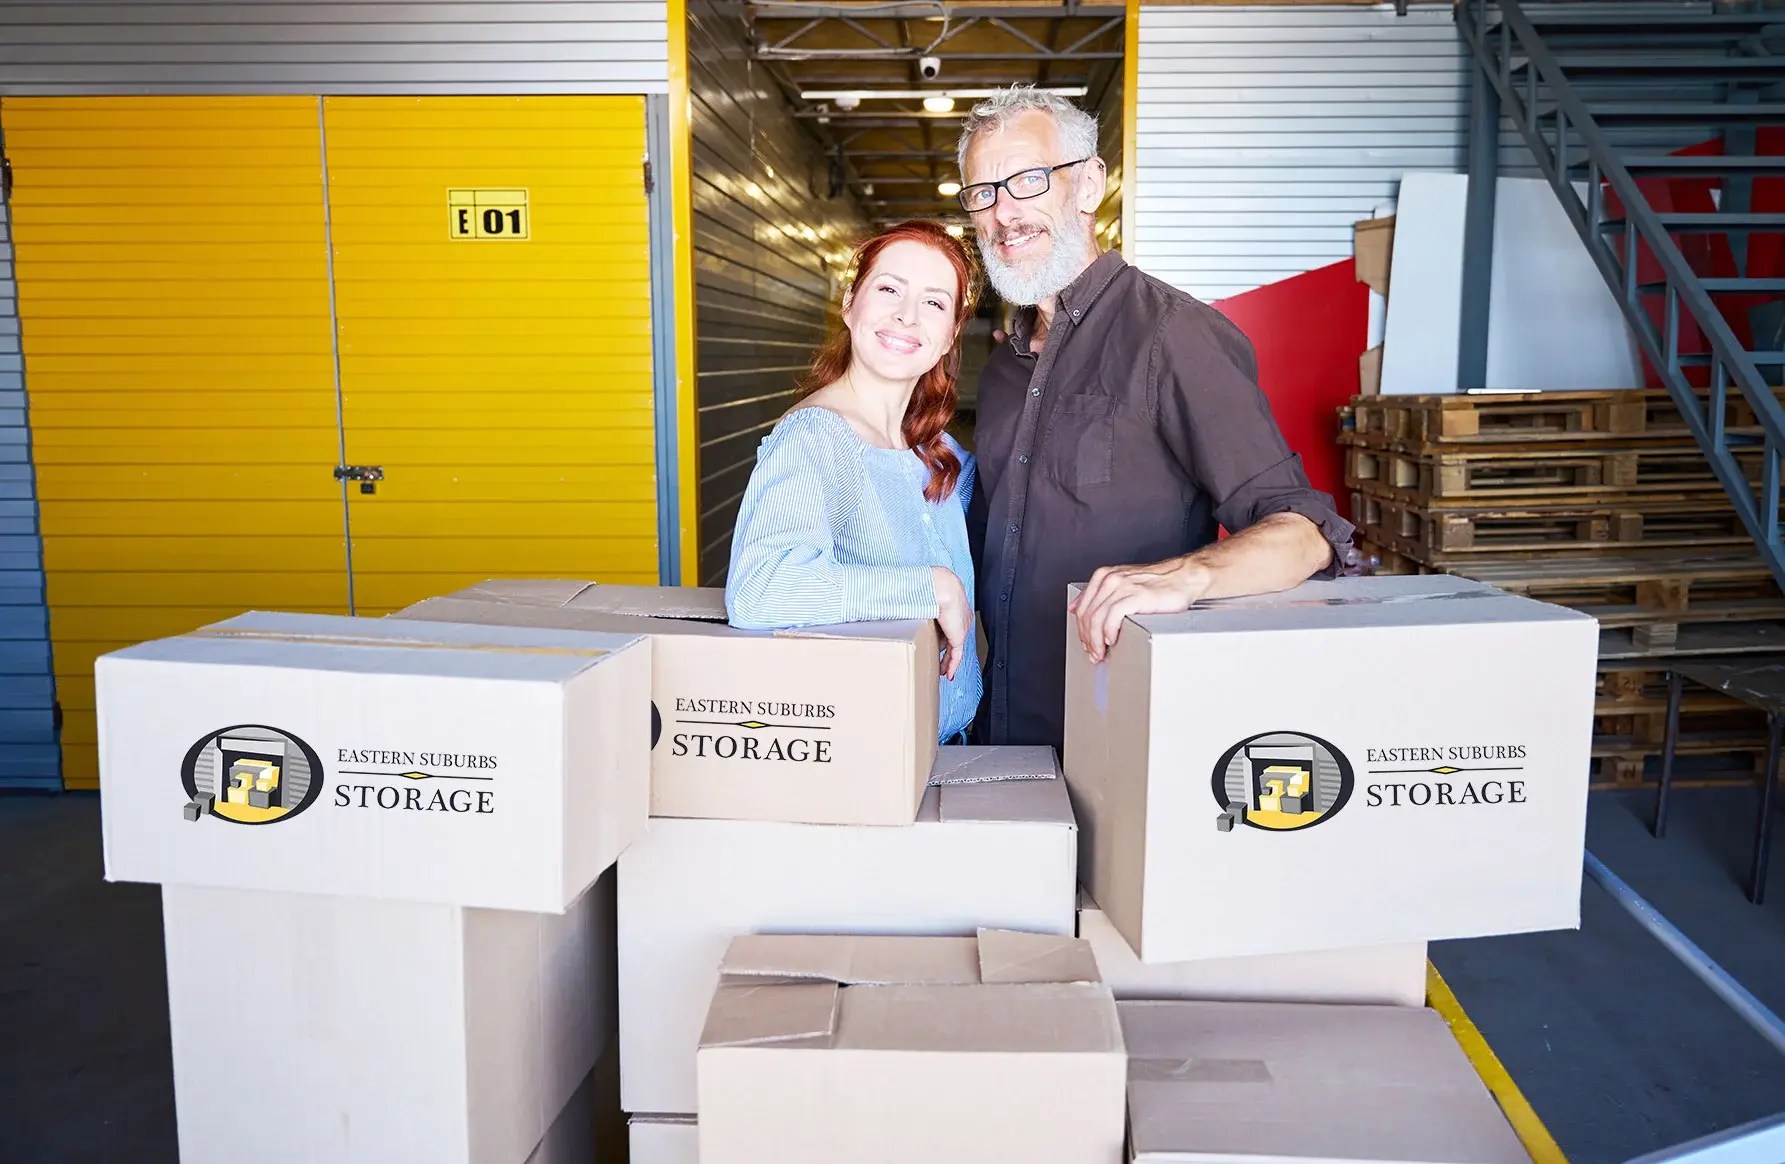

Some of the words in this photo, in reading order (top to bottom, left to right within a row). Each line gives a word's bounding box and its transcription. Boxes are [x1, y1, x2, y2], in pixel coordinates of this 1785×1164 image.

[458, 209, 469, 234] E
[483, 209, 520, 235] 01
[675, 698, 752, 714] EASTERN
[757, 702, 835, 718] SUBURBS
[338, 749, 415, 765] EASTERN
[419, 753, 497, 769] SUBURBS
[672, 733, 832, 763] STORAGE
[1367, 747, 1444, 762] EASTERN
[1448, 745, 1526, 760] SUBURBS
[334, 784, 494, 813] STORAGE
[1366, 781, 1527, 807] STORAGE
